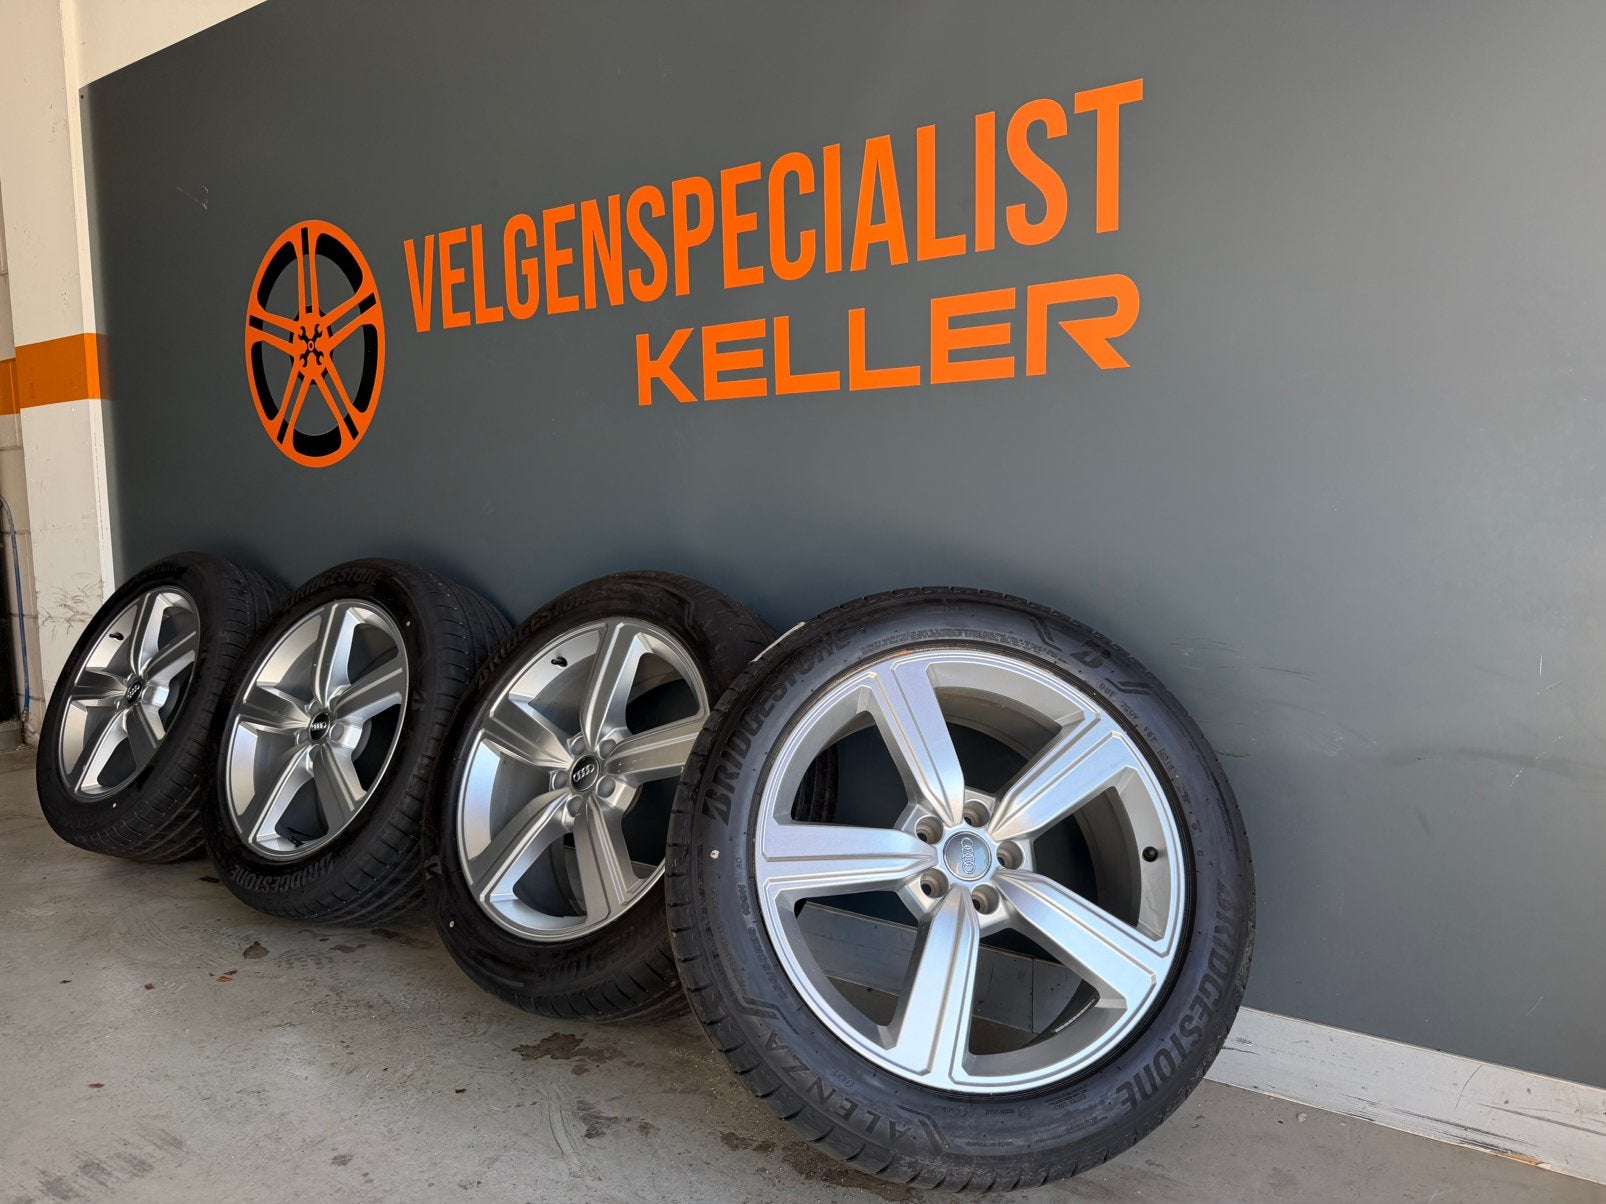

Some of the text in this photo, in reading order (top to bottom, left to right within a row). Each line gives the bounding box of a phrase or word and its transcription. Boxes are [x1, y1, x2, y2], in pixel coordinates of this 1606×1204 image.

[403, 78, 1143, 333] VELGENSPECIALIST
[636, 274, 1140, 406] KELLER
[702, 631, 850, 826] BRIDGESTONE
[763, 1031, 912, 1144] ALENZA
[1116, 879, 1236, 1112] BRIDGESTONE
